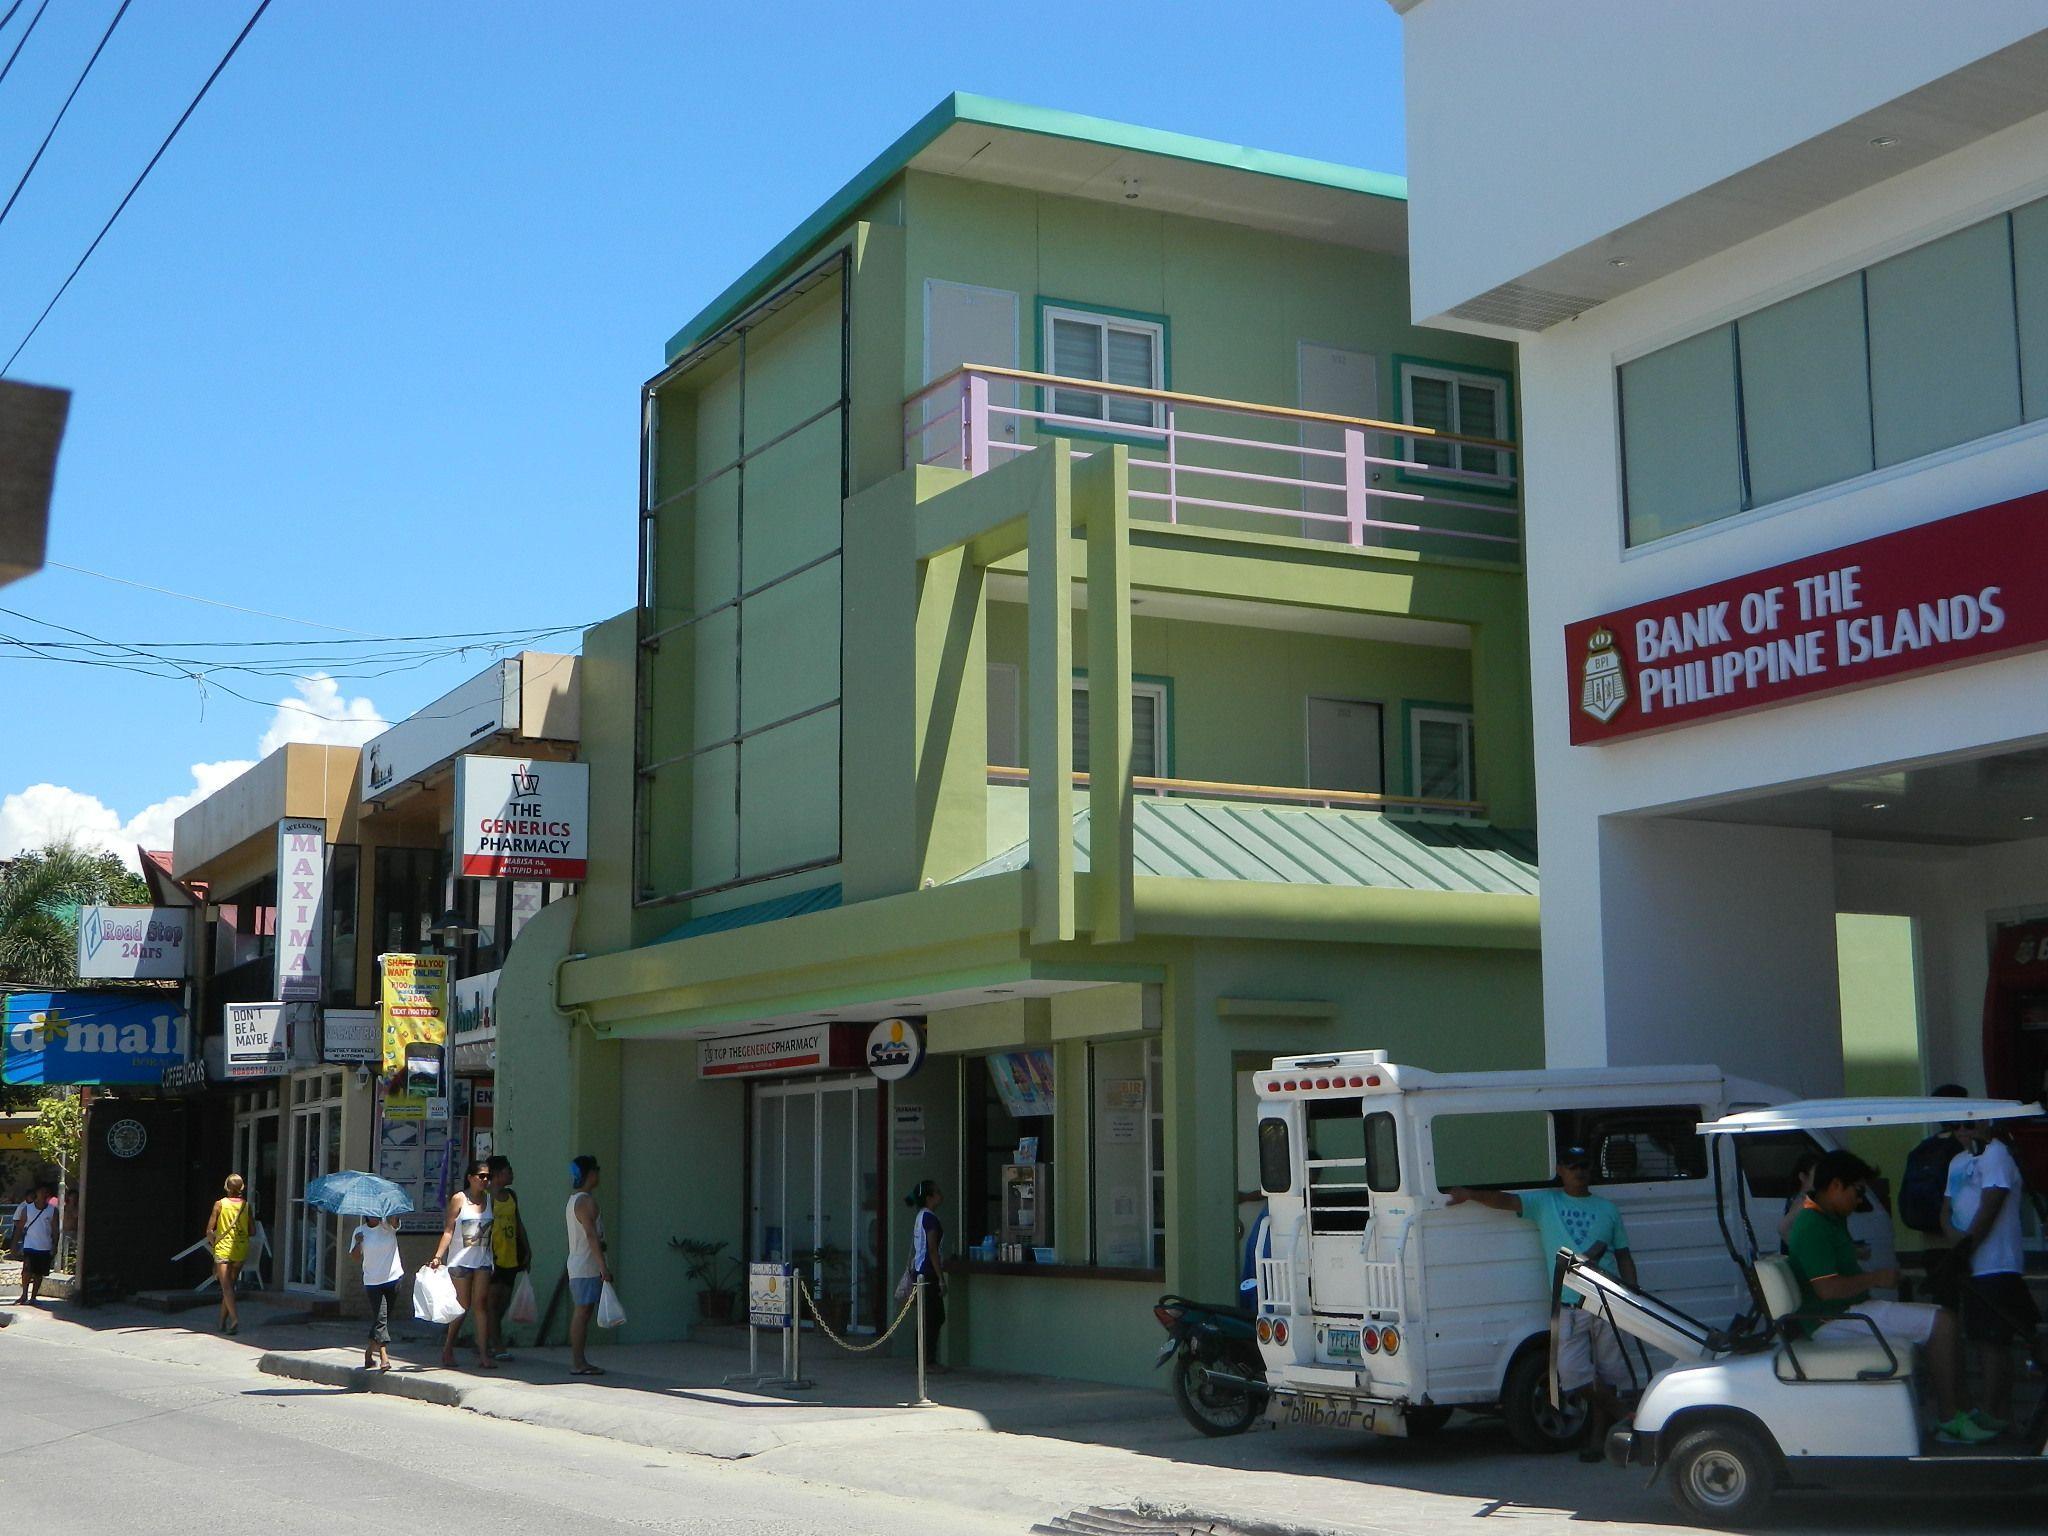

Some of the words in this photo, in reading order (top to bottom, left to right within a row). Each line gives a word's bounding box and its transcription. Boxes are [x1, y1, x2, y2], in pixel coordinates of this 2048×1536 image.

[1636, 601, 1731, 662] BANK
[1740, 586, 1784, 634] OF
[1793, 565, 1862, 621] THE
[1639, 630, 1826, 713] PHILIPPINE
[1836, 586, 2005, 666] ISLANDS
[1595, 655, 1609, 669] BPI
[509, 803, 542, 818] THE
[286, 822, 322, 833] WELCOME
[480, 818, 571, 837] GENERICS
[480, 836, 571, 854] PHARMACY
[504, 857, 533, 866] MABISA
[499, 866, 532, 874] MATIPID
[287, 834, 317, 971] MAXIMA
[102, 920, 142, 941] Road
[147, 920, 183, 947] Stop
[121, 942, 162, 959] 24hrs
[387, 959, 412, 967] SHARE
[233, 1008, 262, 1022] DON'T
[235, 1023, 247, 1035] BE
[250, 1022, 256, 1033] A
[235, 1033, 269, 1047] MAYBE
